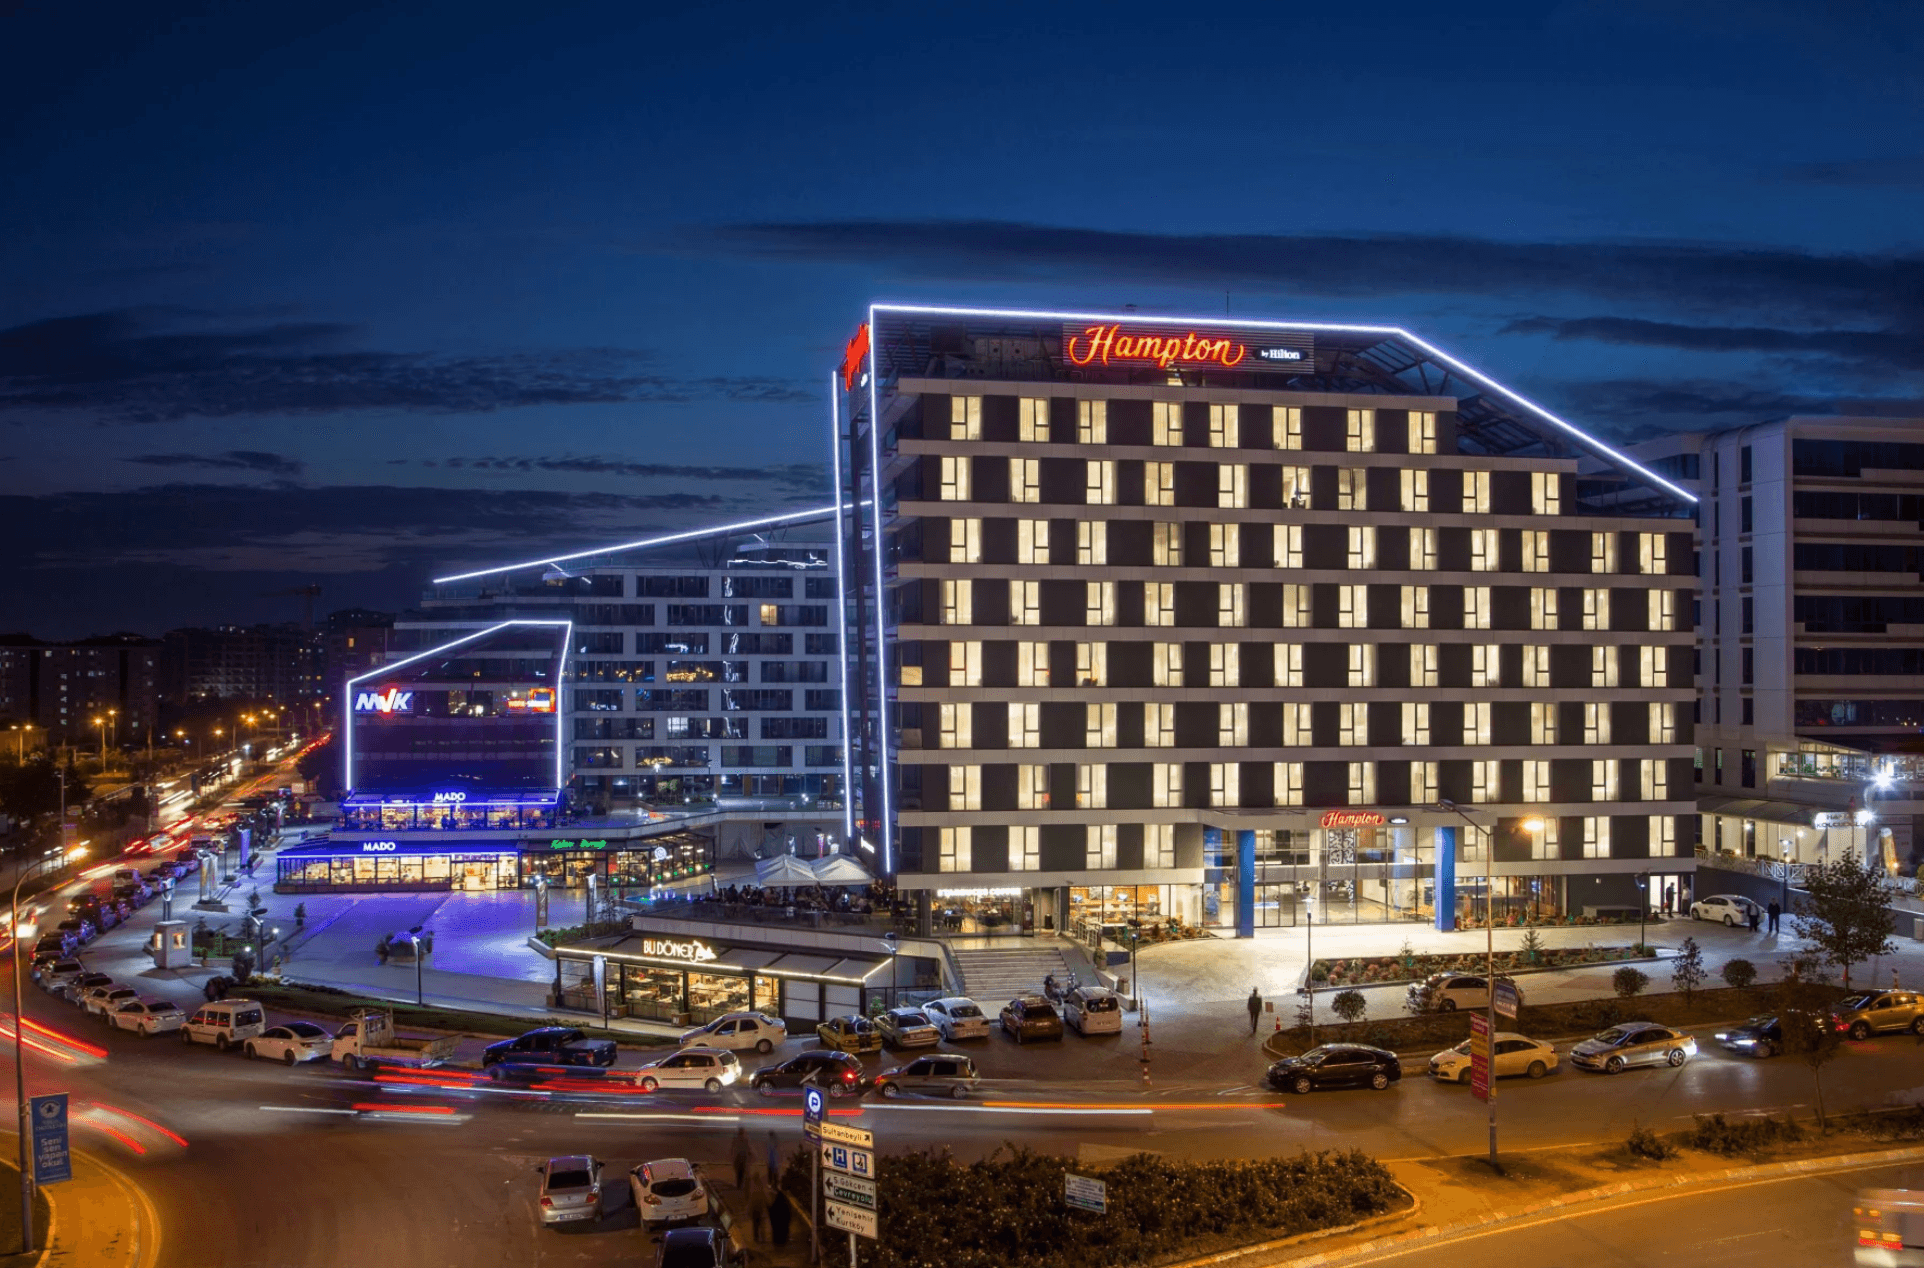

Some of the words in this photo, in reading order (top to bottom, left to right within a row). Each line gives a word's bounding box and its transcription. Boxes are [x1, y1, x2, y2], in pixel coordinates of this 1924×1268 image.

[1068, 324, 1245, 367] Hampton
[1269, 348, 1300, 359] Hilton
[434, 791, 466, 801] MADO
[1321, 811, 1385, 828] Hampton
[363, 841, 396, 851] MADO
[657, 940, 694, 958] DÖNER
[823, 1126, 862, 1141] Sultanbeyli
[835, 1149, 845, 1162] H
